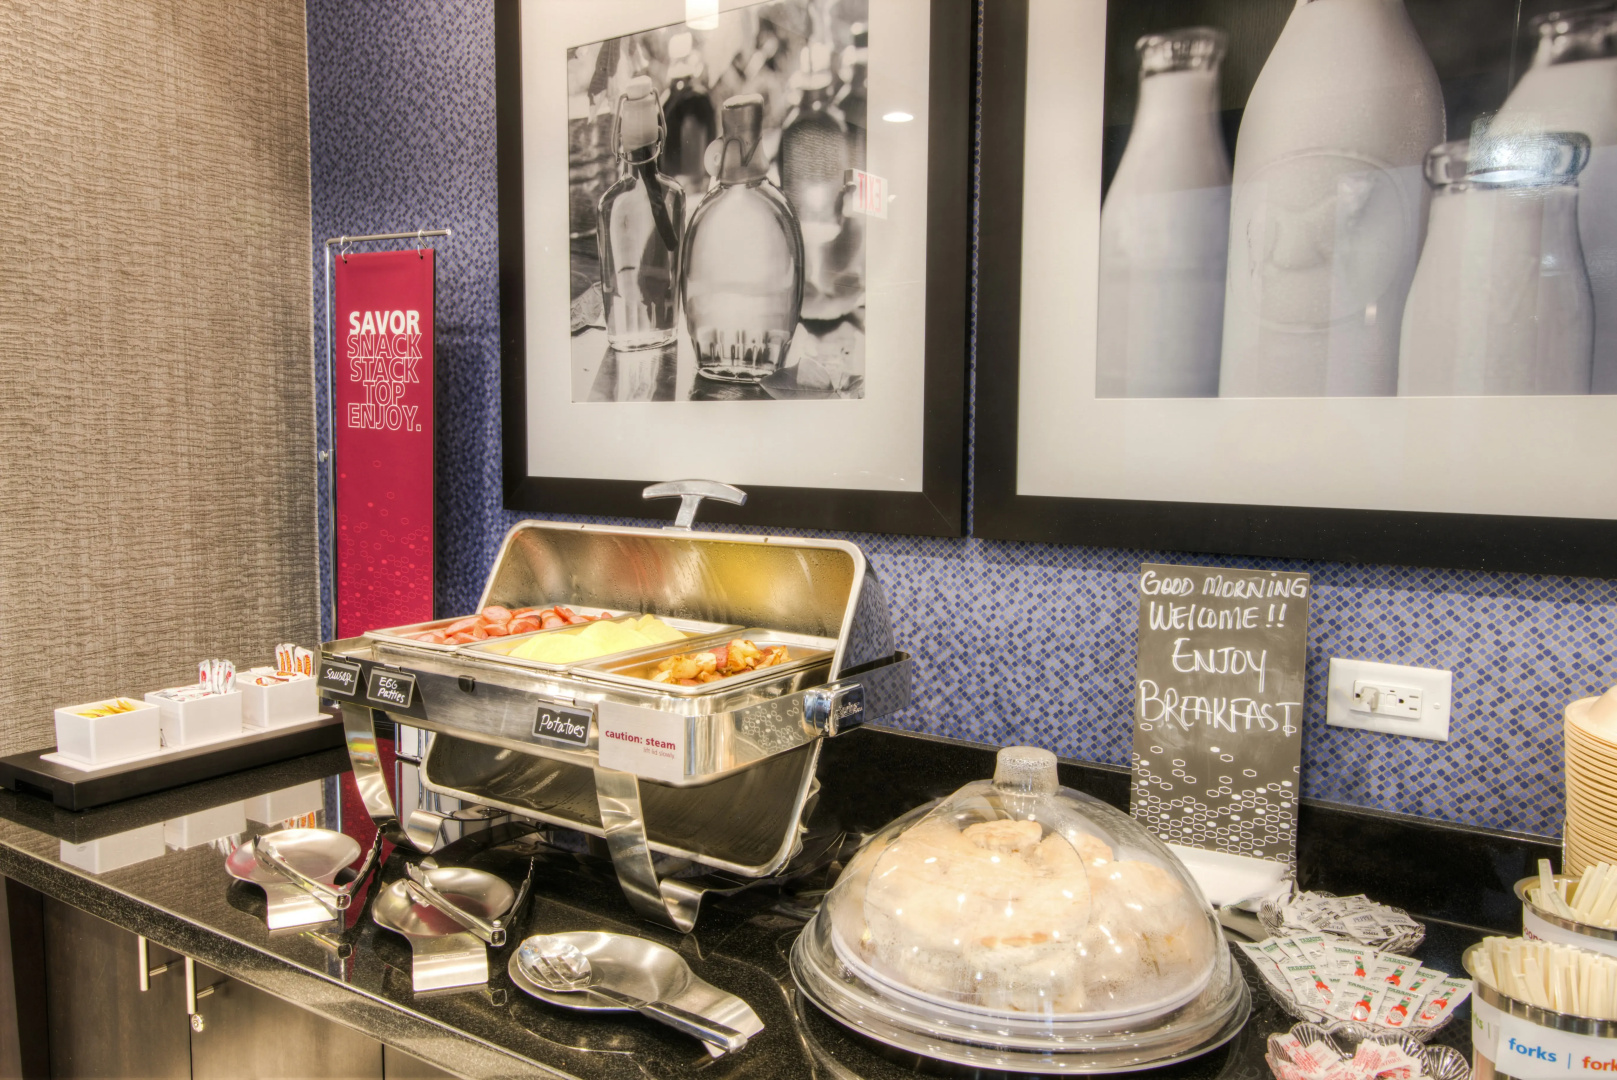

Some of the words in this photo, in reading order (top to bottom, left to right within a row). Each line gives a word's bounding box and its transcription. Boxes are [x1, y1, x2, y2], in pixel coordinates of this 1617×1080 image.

[349, 310, 420, 335] SAVOR
[347, 333, 422, 358] SNACK
[350, 357, 419, 383] STACK
[363, 380, 405, 406] TOP
[348, 403, 421, 431] ENJOY.
[1140, 570, 1195, 597] GOOD
[1171, 637, 1267, 693] ENJOY
[1139, 679, 1301, 738] BREAKFAST
[539, 713, 585, 738] Potatoes
[605, 730, 643, 744] caution:
[645, 737, 675, 750] steam
[1508, 1038, 1557, 1062] forks
